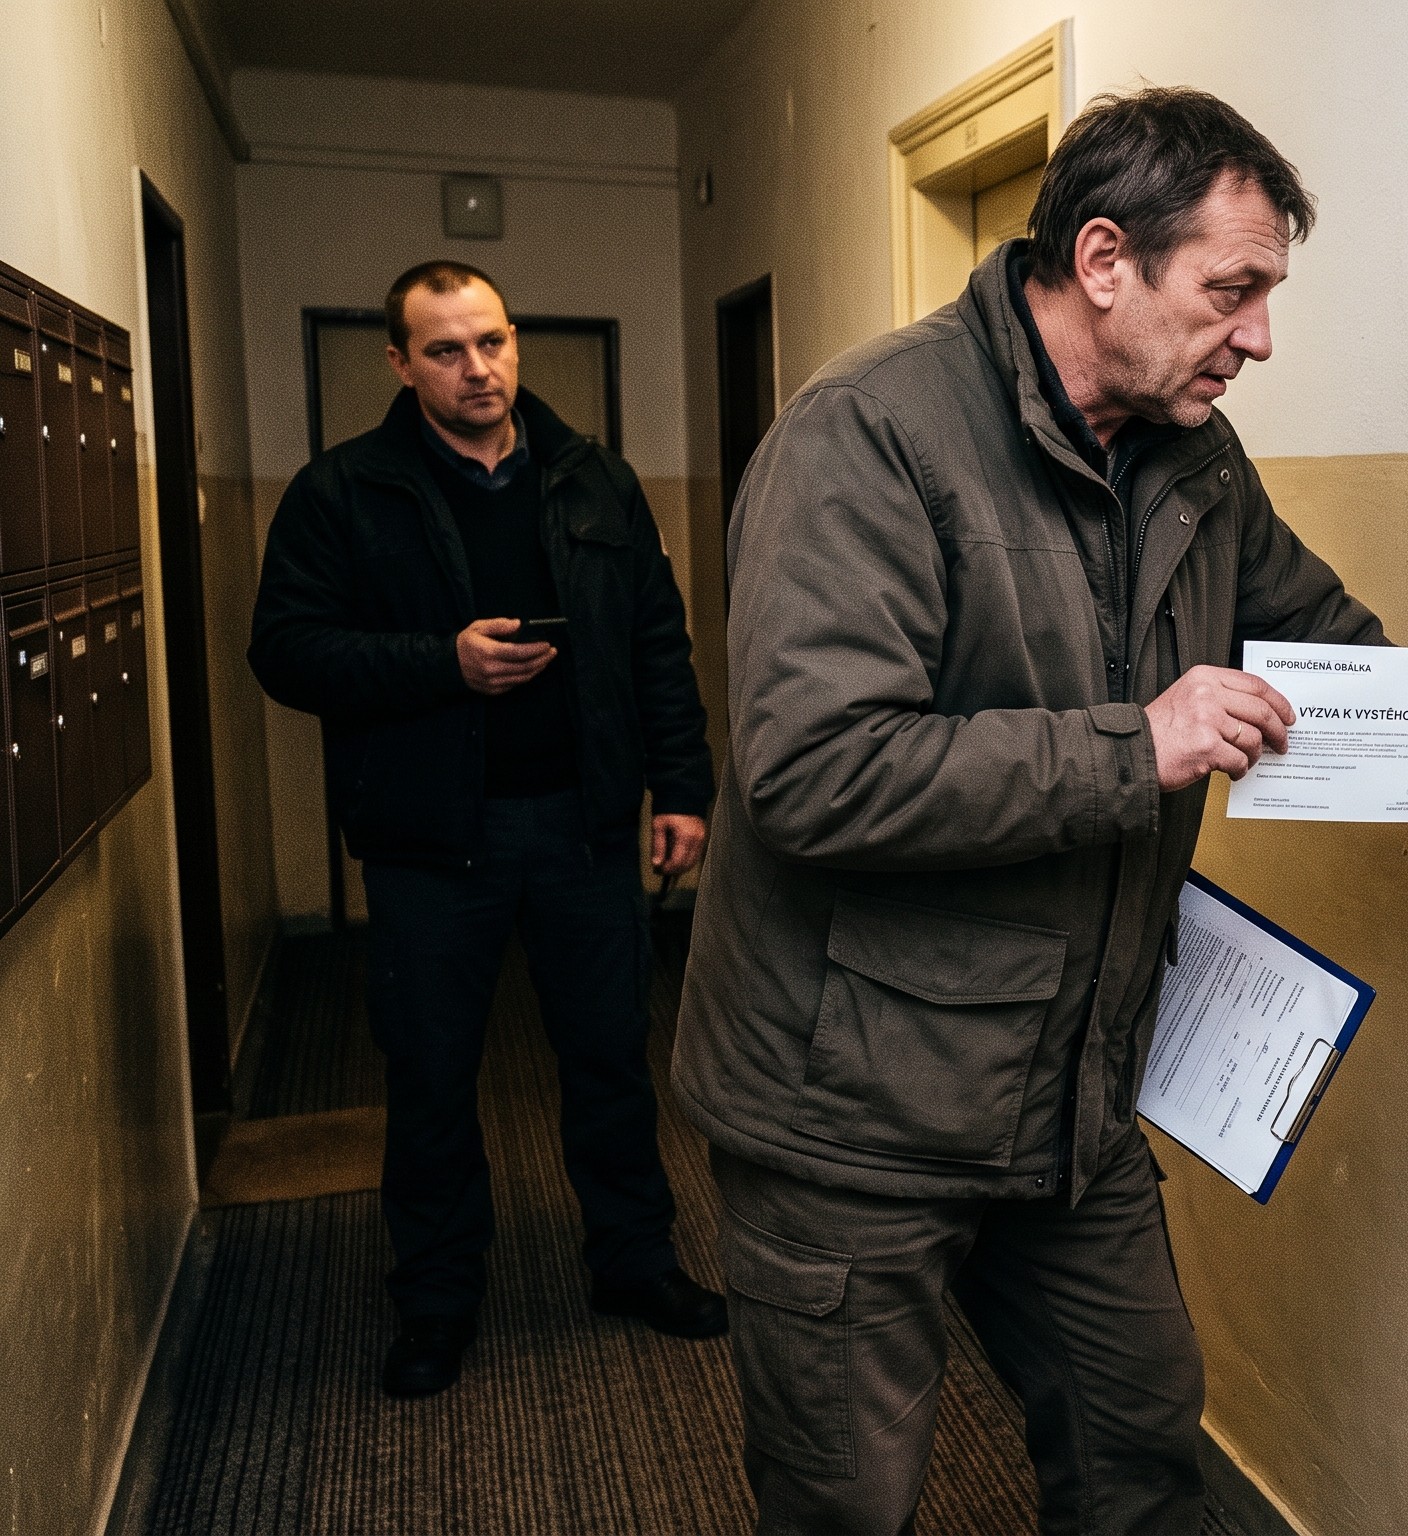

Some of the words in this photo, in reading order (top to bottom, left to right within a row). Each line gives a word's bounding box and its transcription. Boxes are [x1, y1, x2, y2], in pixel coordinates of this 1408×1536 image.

[1266, 659, 1333, 672] DOPORUČENÁ
[1334, 661, 1372, 673] OBÁLKA
[1299, 705, 1340, 719] VÝZVA
[1343, 708, 1353, 719] K
